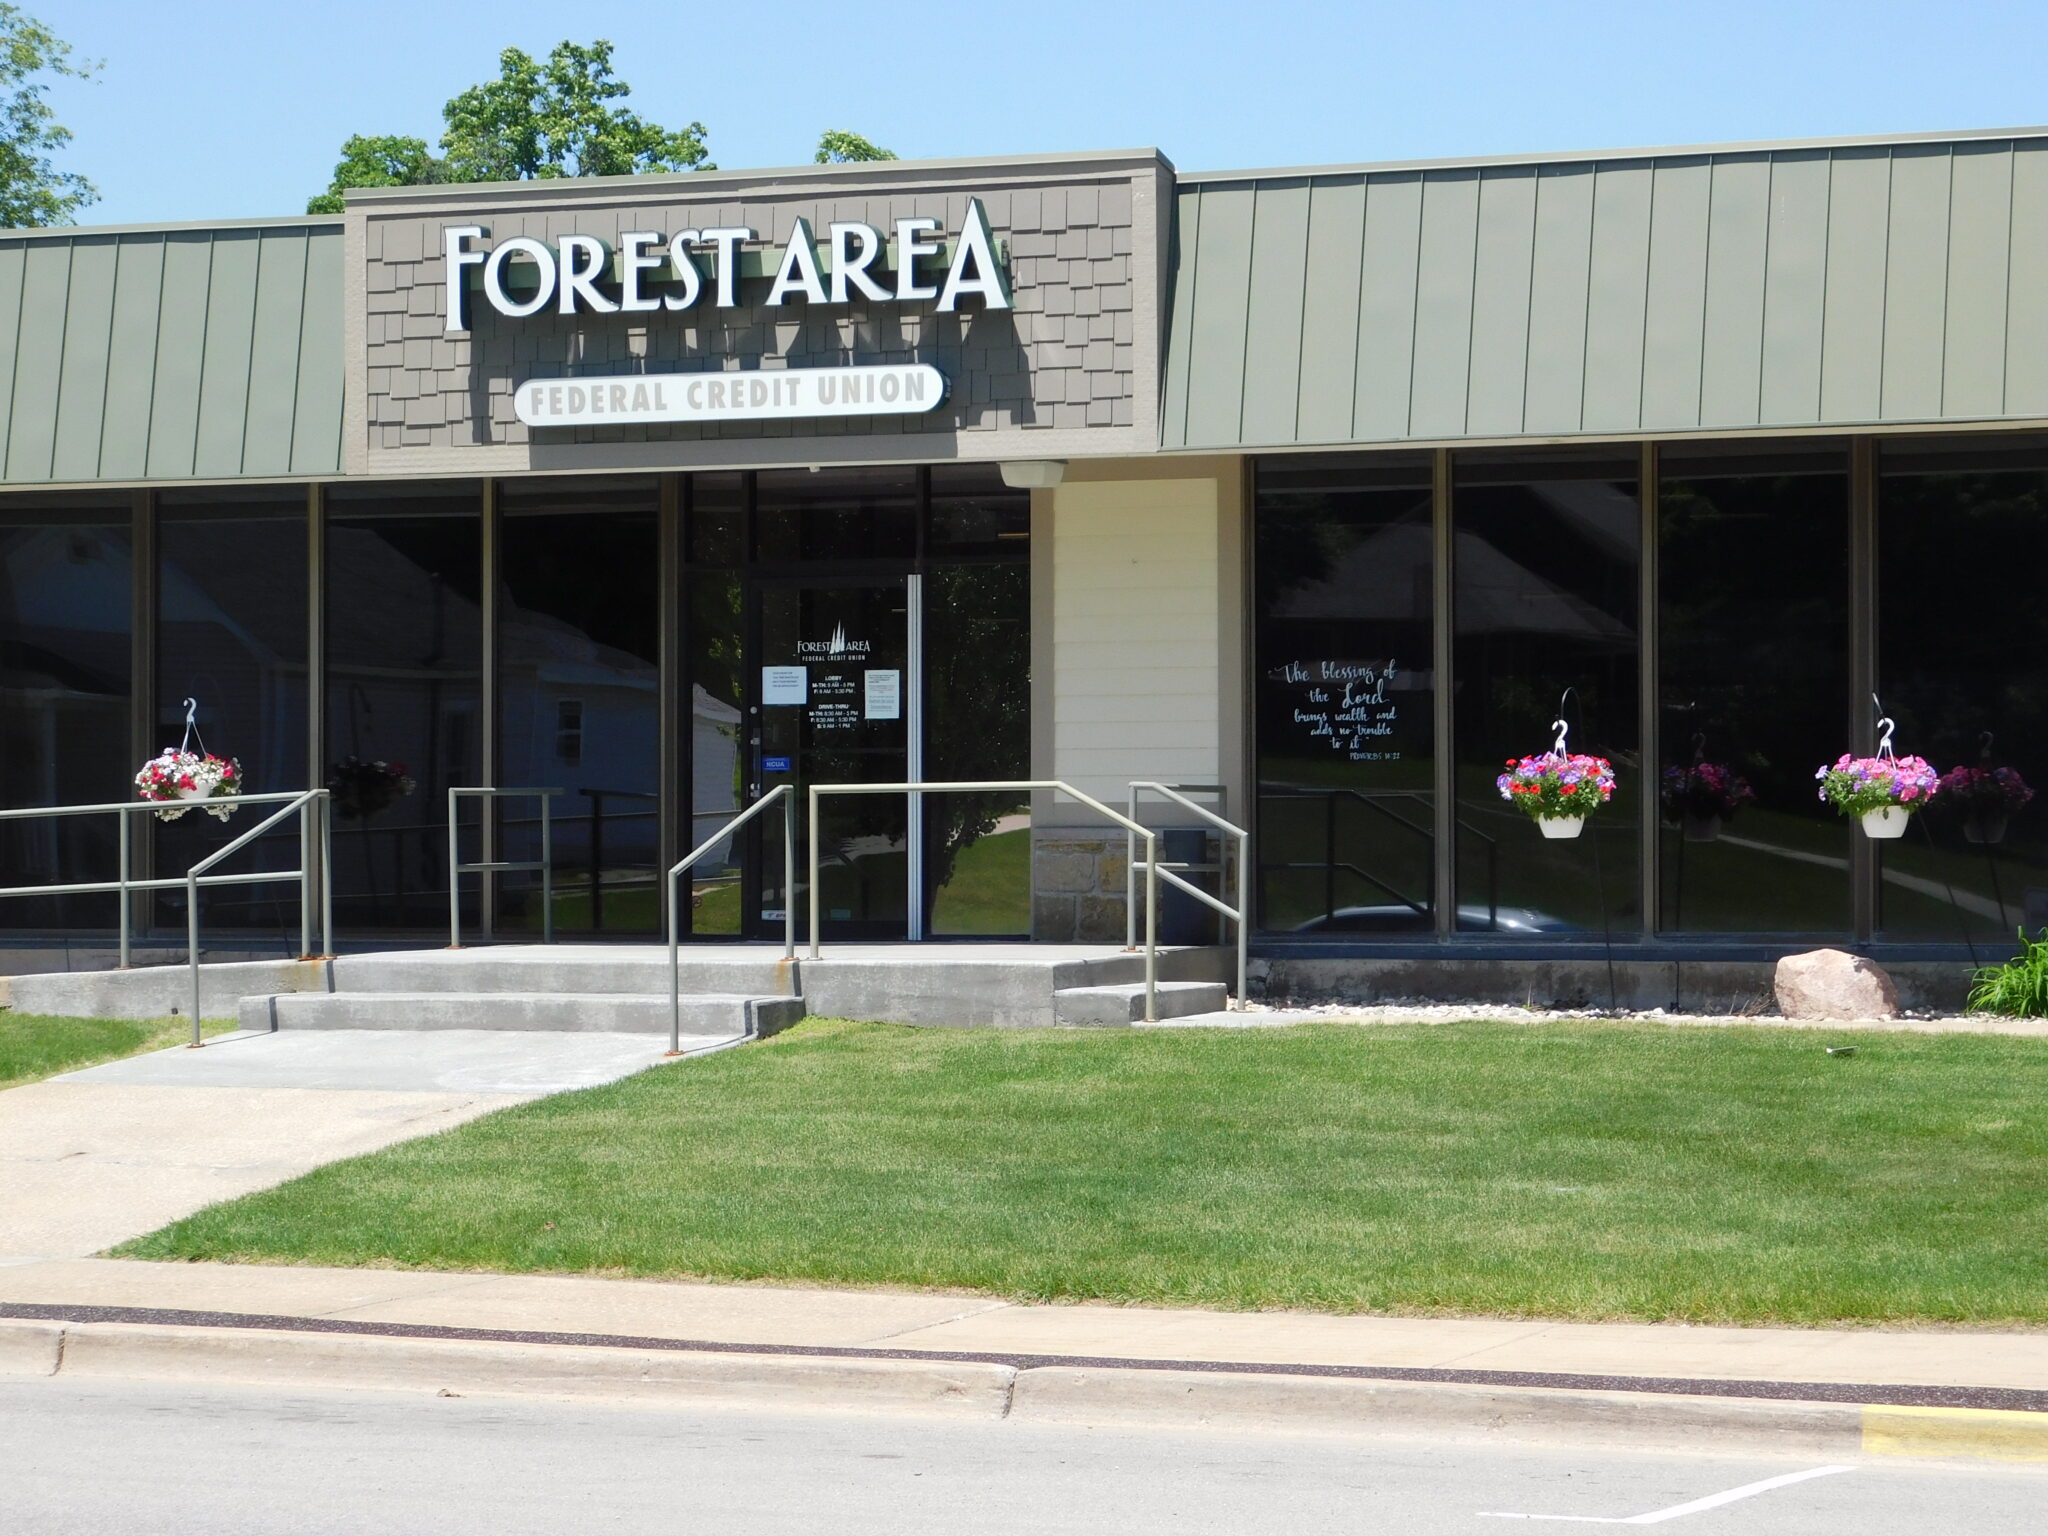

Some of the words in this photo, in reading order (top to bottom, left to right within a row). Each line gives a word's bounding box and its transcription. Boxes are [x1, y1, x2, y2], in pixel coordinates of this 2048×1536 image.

[443, 225, 757, 331] FOREST
[765, 197, 1012, 312] AREA
[530, 381, 668, 416] FEDERAL
[687, 376, 800, 410] CREDIT
[817, 372, 926, 405] UNION
[797, 640, 831, 653] FOREST
[846, 640, 870, 652] AREA
[1321, 660, 1374, 684] blessing
[1383, 658, 1397, 679] of
[1308, 687, 1330, 703] the
[1337, 678, 1390, 708] Lord
[1294, 708, 1327, 723] brings
[1334, 707, 1370, 722] wealth
[1376, 706, 1397, 720] and
[1310, 722, 1333, 736] adds
[1339, 726, 1352, 735] no
[1353, 722, 1393, 736] trouble
[1329, 736, 1343, 749] to
